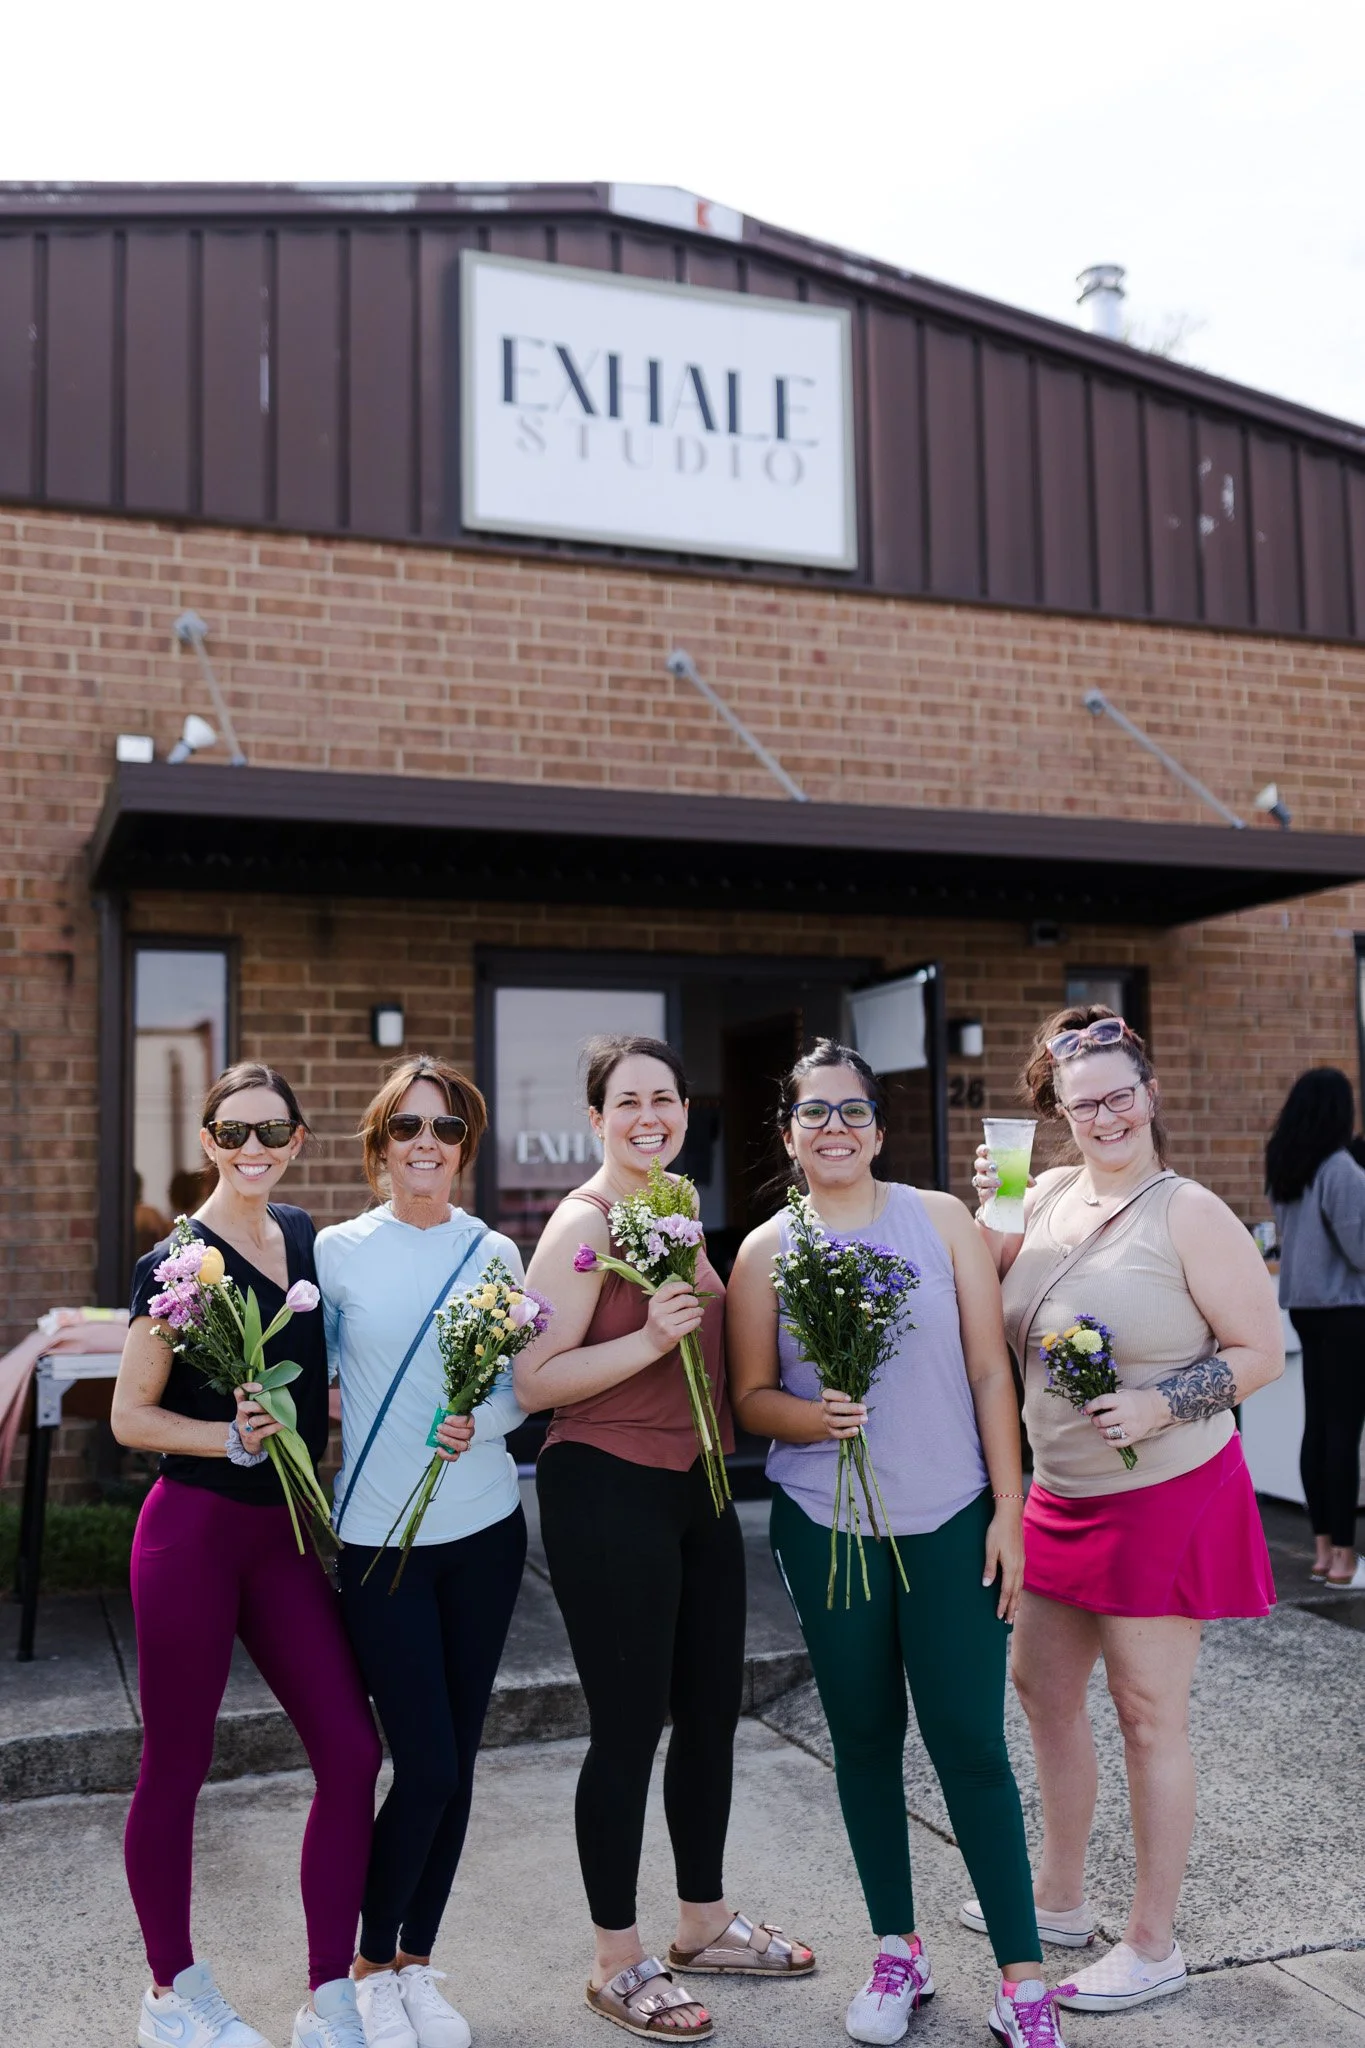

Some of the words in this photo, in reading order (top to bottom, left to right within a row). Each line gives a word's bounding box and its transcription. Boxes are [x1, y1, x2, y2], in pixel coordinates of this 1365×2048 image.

[500, 335, 819, 448] EXHALE
[515, 411, 806, 487] STUDIO
[516, 1130, 604, 1164] EXHA
